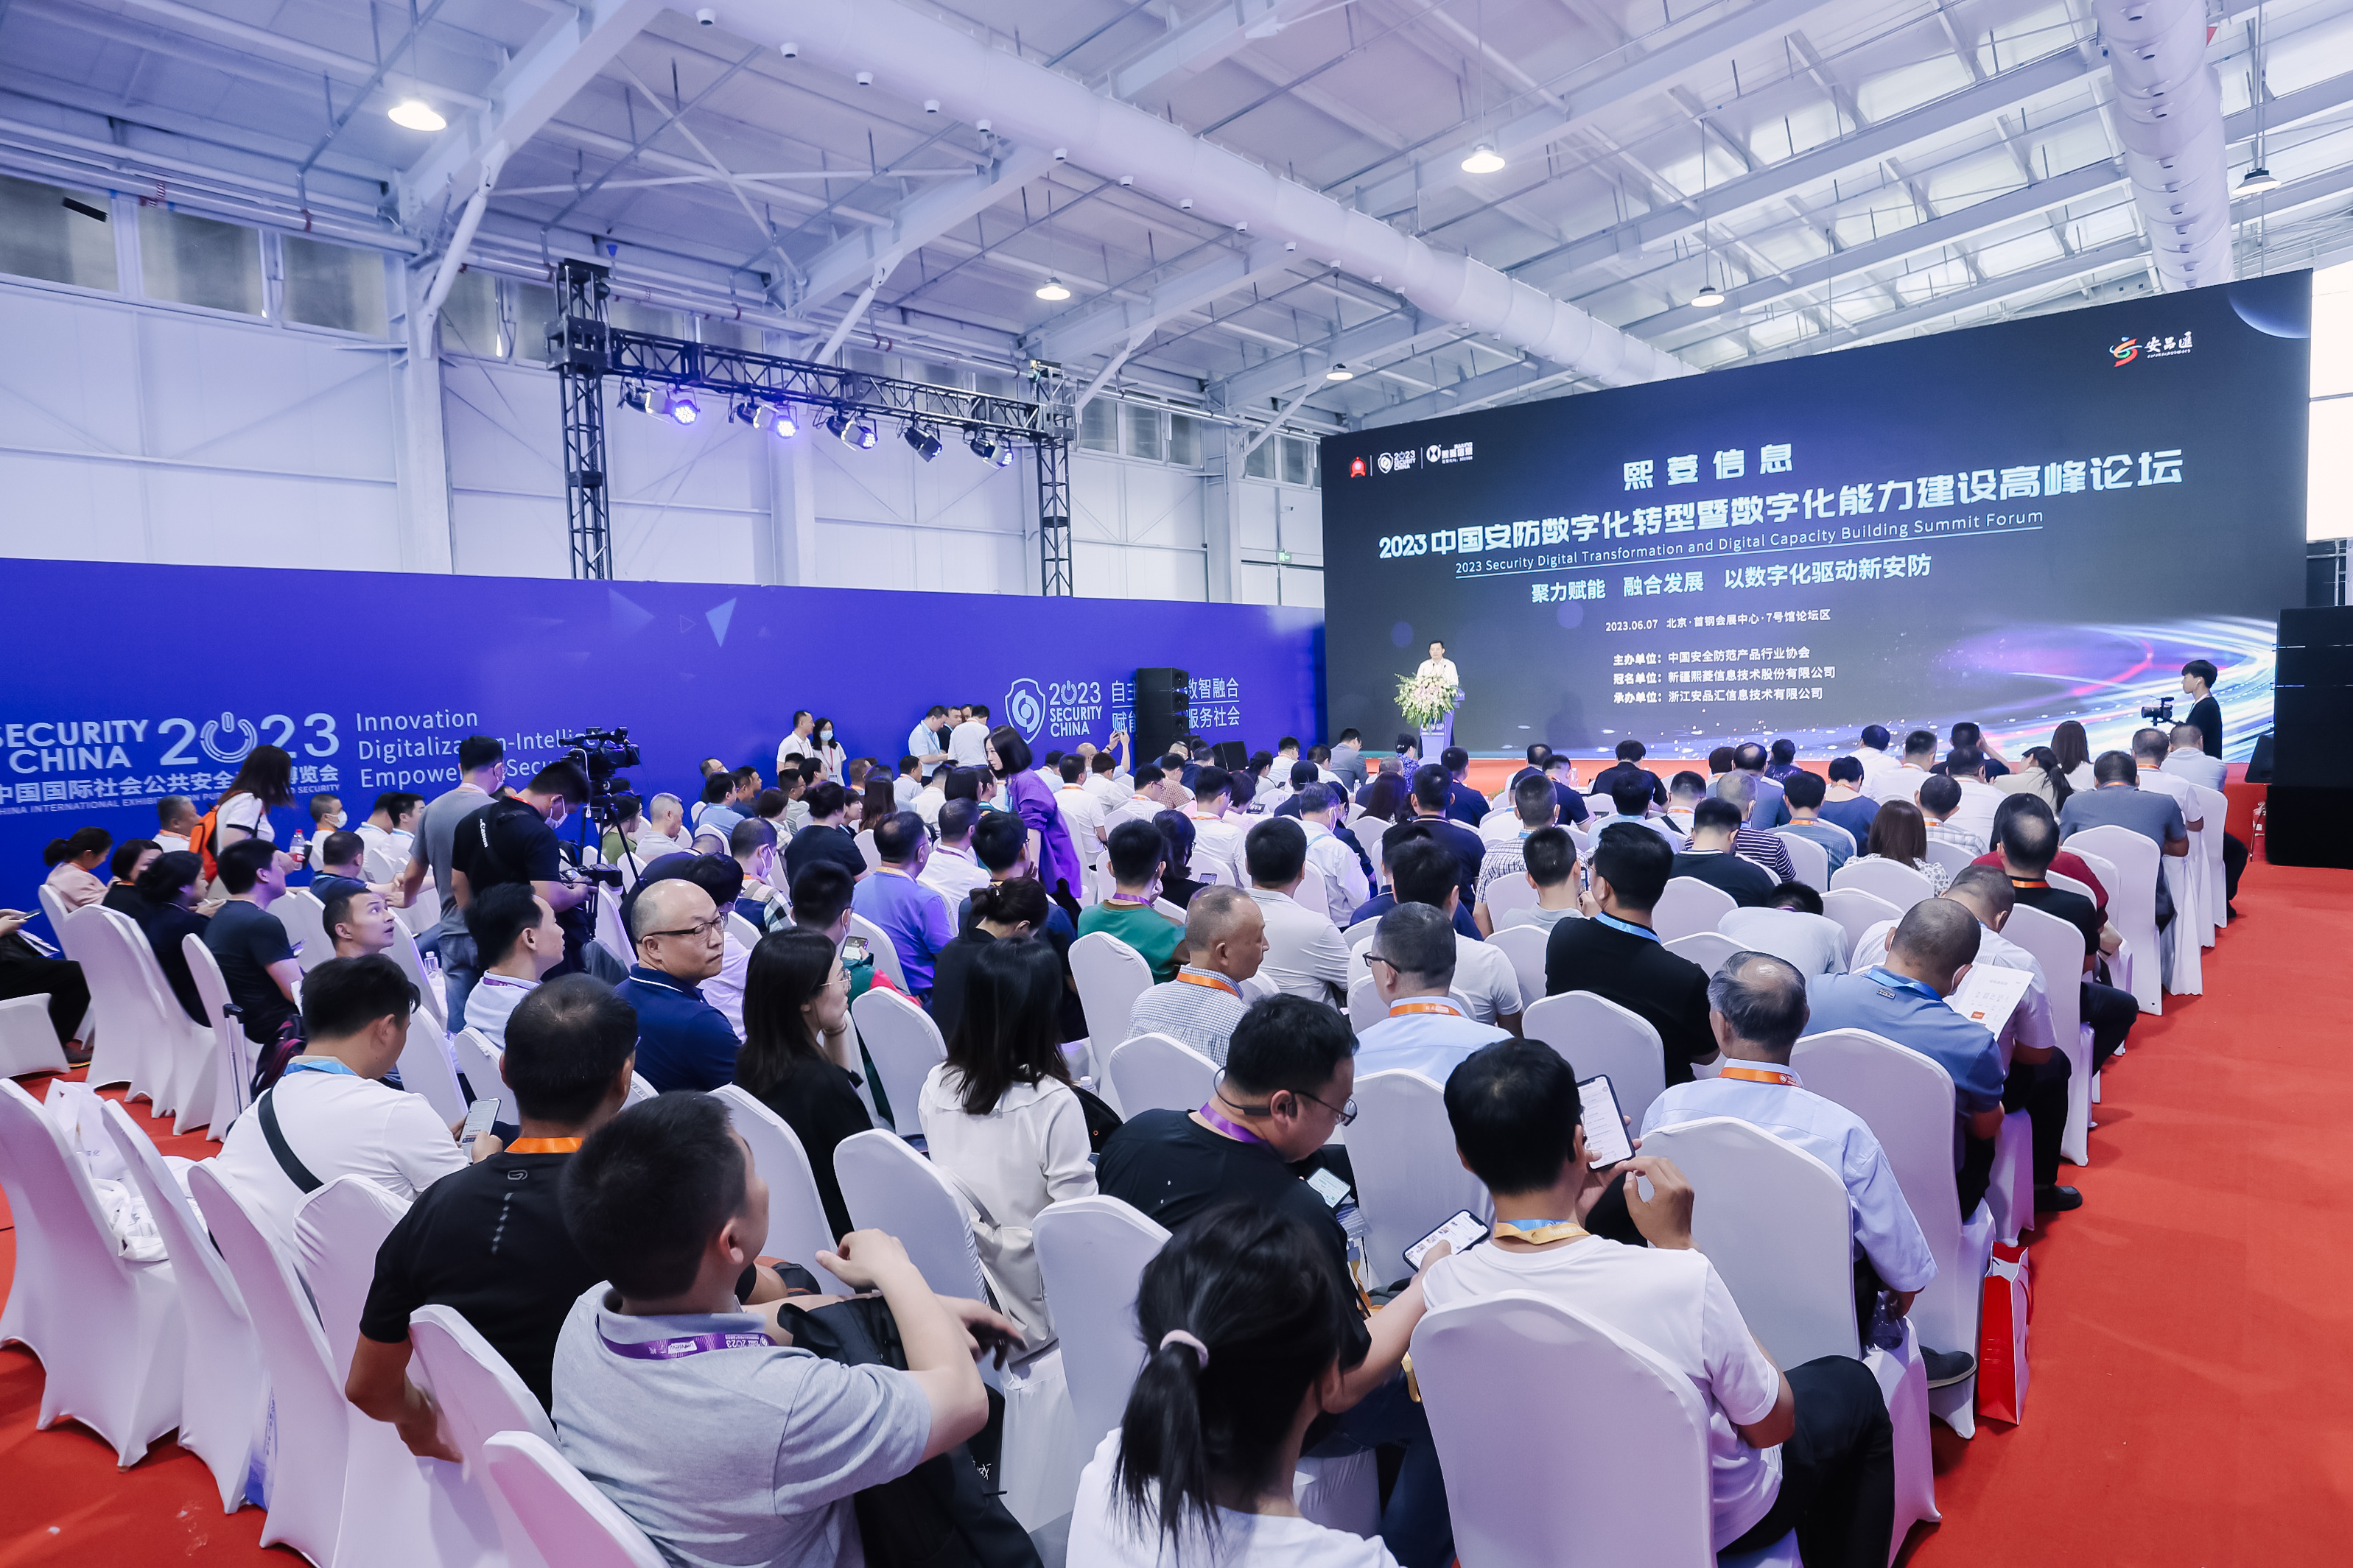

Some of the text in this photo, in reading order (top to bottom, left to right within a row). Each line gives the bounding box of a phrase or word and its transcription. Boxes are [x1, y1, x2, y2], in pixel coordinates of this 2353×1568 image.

[1623, 443, 1793, 491] 熙菱信息
[1456, 510, 2044, 574] 2023 Security Digital Transformation and Digital Capacity Building Summit Forum
[1531, 552, 1932, 603] 聚力赋能 融合发展 以数字化驱动新安防
[1605, 619, 1658, 632] 2023.06.07
[1048, 680, 1102, 706] 2023
[1111, 680, 1137, 703] 自主
[356, 709, 478, 732] Innovation
[1049, 706, 1102, 723] SECURITY
[158, 711, 340, 765] 2023
[1049, 721, 1090, 738] CHINA
[9, 745, 133, 773] CHINA
[0, 806, 28, 815] HINA
[30, 799, 120, 813] INTERNATIONAL
[122, 796, 163, 806] EXHIBIT
[298, 784, 340, 794] SECURITY
[480, 820, 489, 848] Canon
